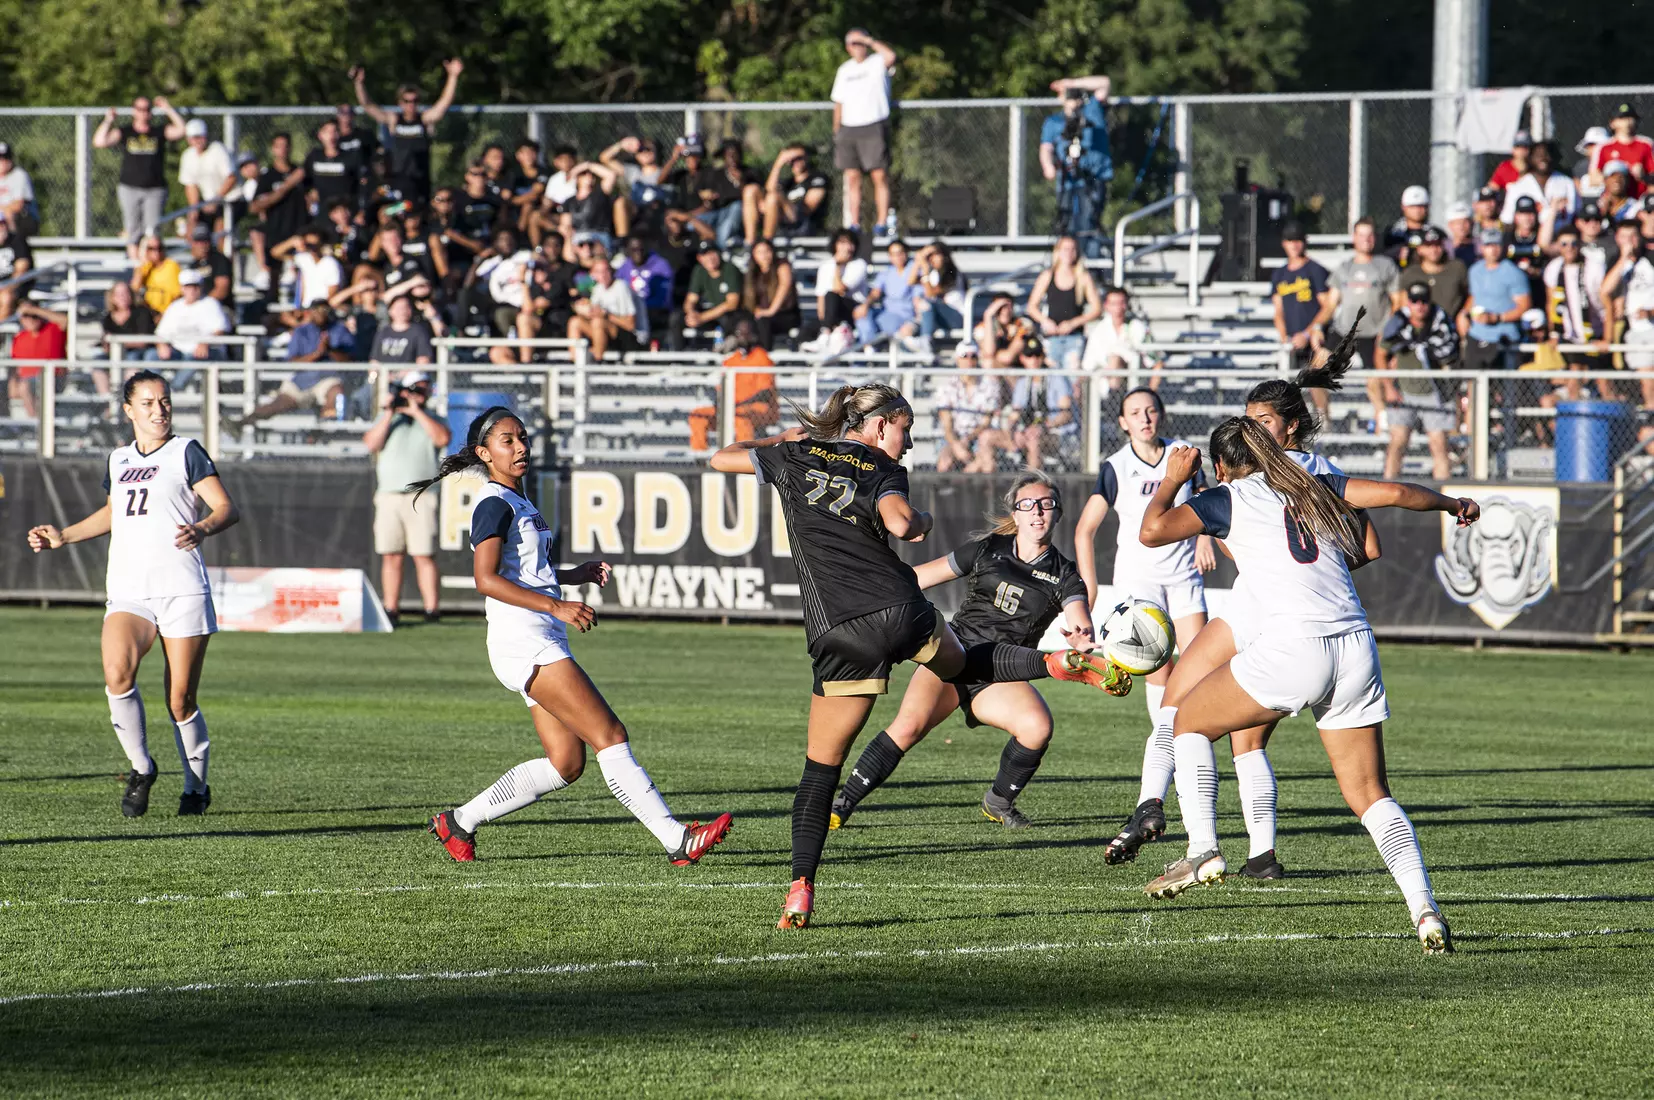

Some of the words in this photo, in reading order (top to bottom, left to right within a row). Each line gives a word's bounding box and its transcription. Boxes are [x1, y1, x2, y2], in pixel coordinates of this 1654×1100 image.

[119, 466, 159, 483] UIC
[808, 446, 876, 472] MASTODONS
[126, 488, 149, 517] 22
[440, 469, 794, 557] PRDU
[613, 564, 765, 610] WAYNE
[993, 581, 1025, 616] 16
